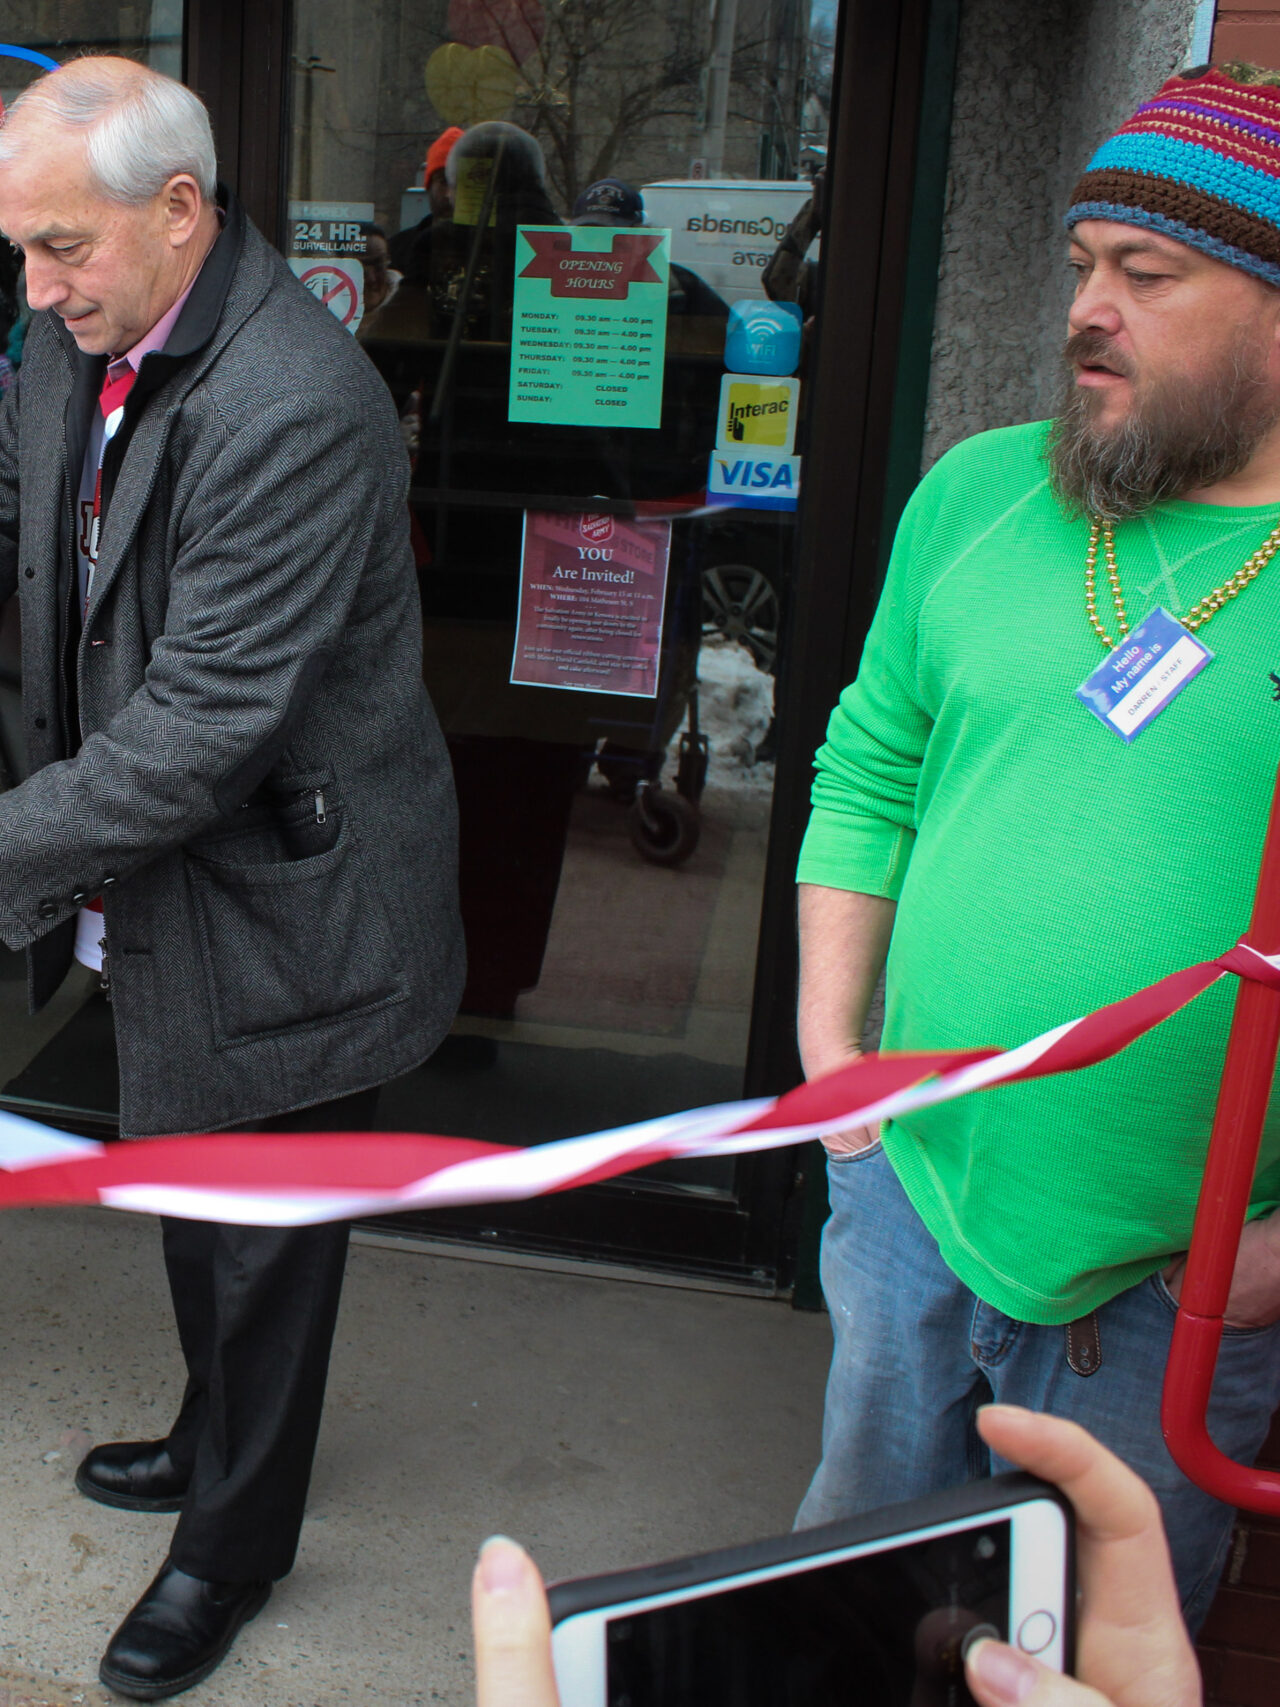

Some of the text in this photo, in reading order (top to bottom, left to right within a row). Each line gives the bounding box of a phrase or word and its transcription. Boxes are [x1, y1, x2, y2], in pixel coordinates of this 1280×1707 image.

[294, 223, 367, 242] 24 HR.
[293, 241, 367, 252] SURVEILLANCE
[559, 259, 624, 273] OPENING
[565, 277, 615, 289] HOURS
[521, 312, 559, 320] MONDAY:
[520, 326, 560, 334] TUESDAY:
[519, 340, 571, 348] WEDNESDAY:
[519, 354, 565, 362] THURSDAY:
[518, 367, 550, 375] FRIDAY:
[517, 381, 628, 393] SATURDAY: CLOSED
[516, 395, 552, 403] SUNDAY:
[730, 399, 789, 419] Interac
[715, 459, 793, 489] VISA
[577, 546, 614, 562] YOU
[552, 566, 635, 584] Are Invited!
[1111, 644, 1140, 673] Hello
[1111, 642, 1163, 694] My name is
[1127, 685, 1158, 716] DARREN
[1160, 656, 1184, 682] STAFF
